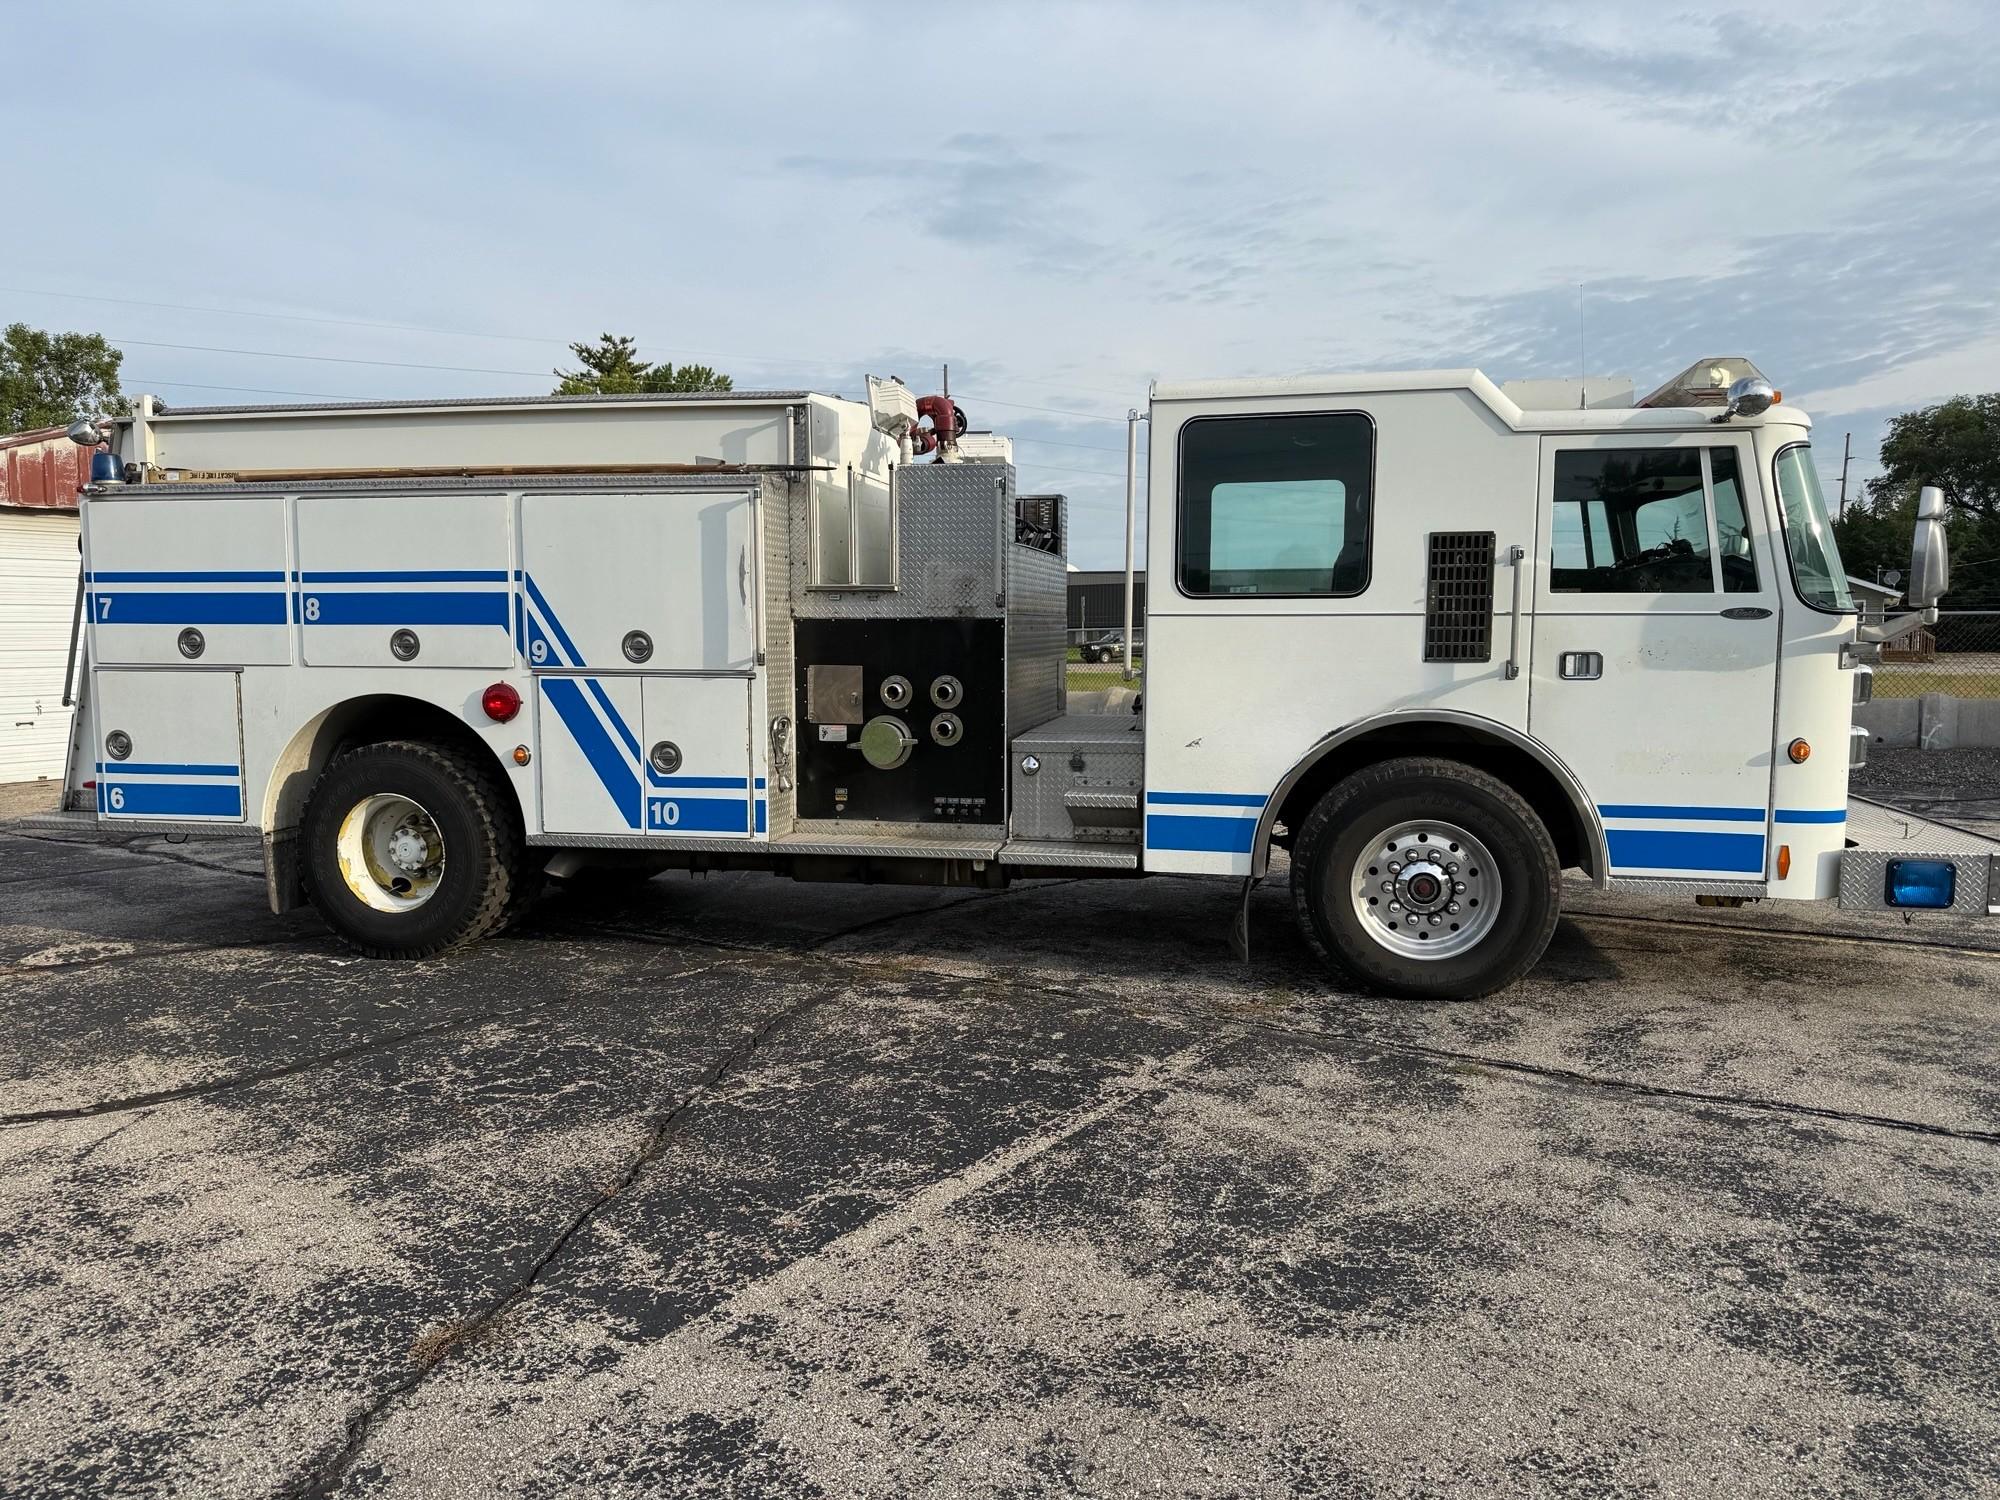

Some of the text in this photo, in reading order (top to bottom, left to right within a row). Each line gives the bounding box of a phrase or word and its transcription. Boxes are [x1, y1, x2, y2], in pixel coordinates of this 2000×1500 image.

[99, 597, 112, 619] 7
[306, 597, 320, 620] 8
[531, 639, 548, 663] 9
[110, 787, 124, 809] 6
[651, 801, 680, 826] 10
